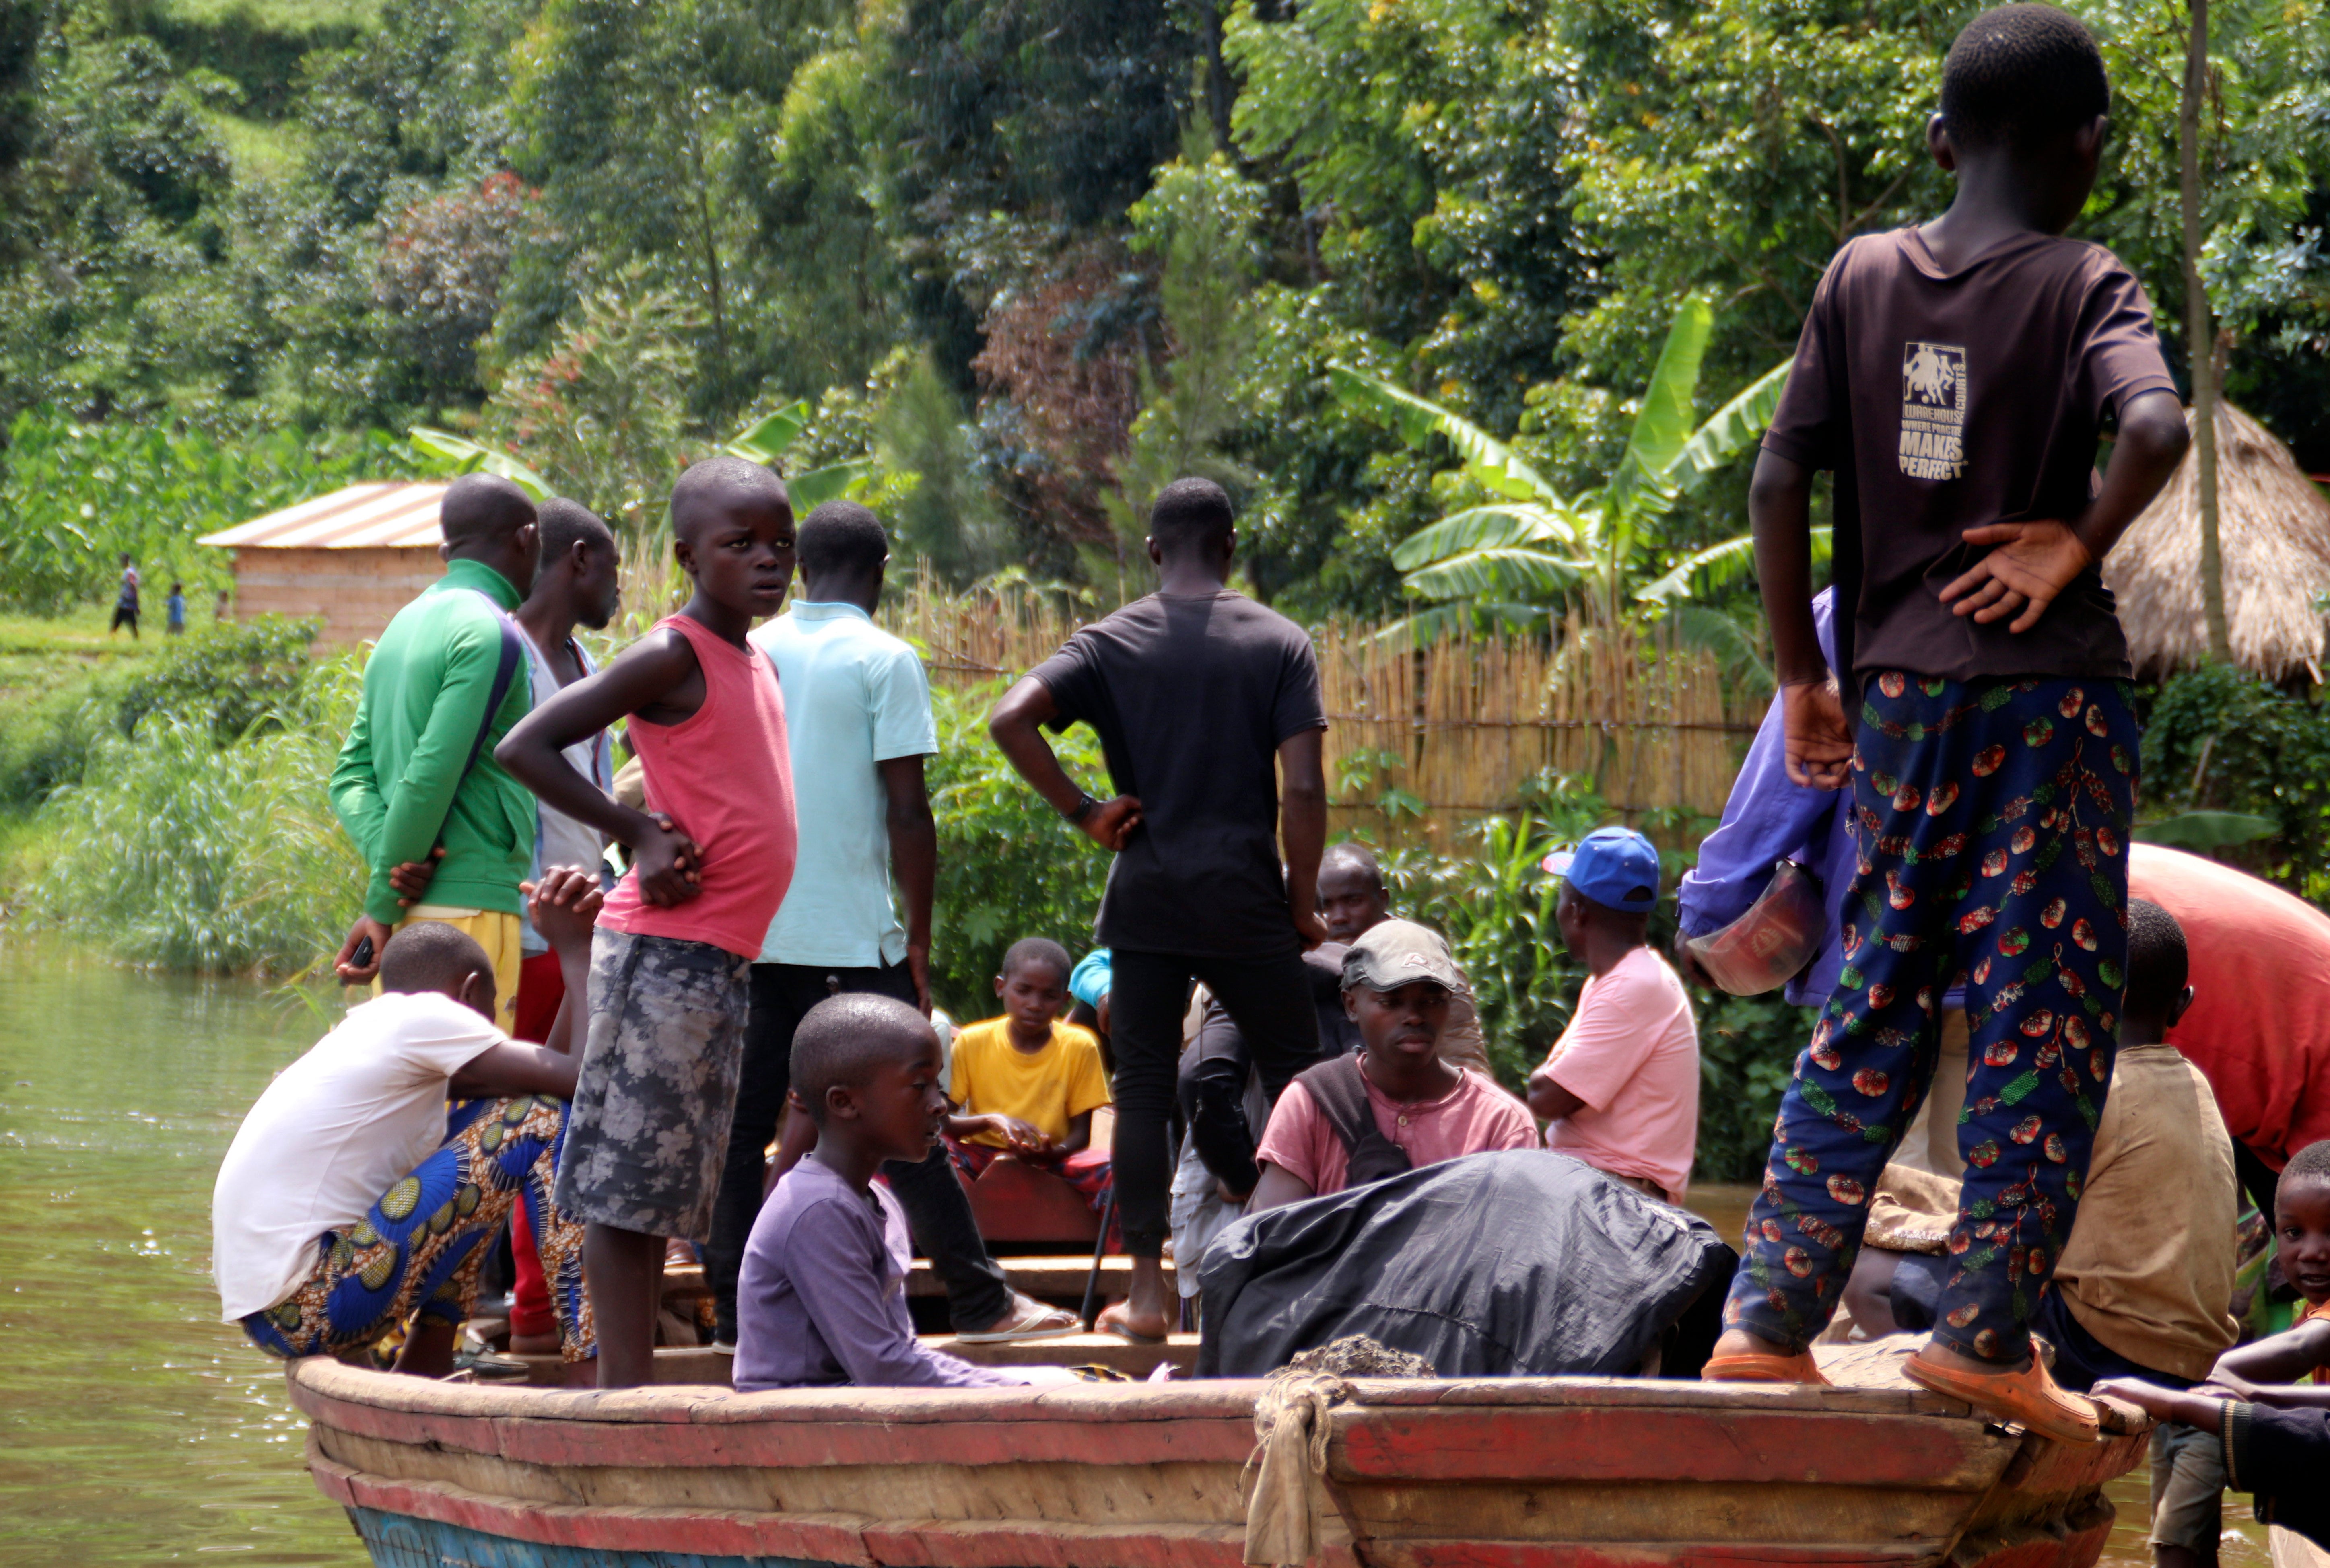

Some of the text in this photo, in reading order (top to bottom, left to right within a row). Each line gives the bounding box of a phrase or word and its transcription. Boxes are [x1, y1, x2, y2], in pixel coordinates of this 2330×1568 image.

[1953, 363, 1967, 410] COURTS
[1901, 420, 1931, 432] WHERE
[1904, 404, 1964, 424] WAREHOUSE
[1899, 431, 1963, 462] MAKES
[1899, 455, 1962, 481] PERFECT
